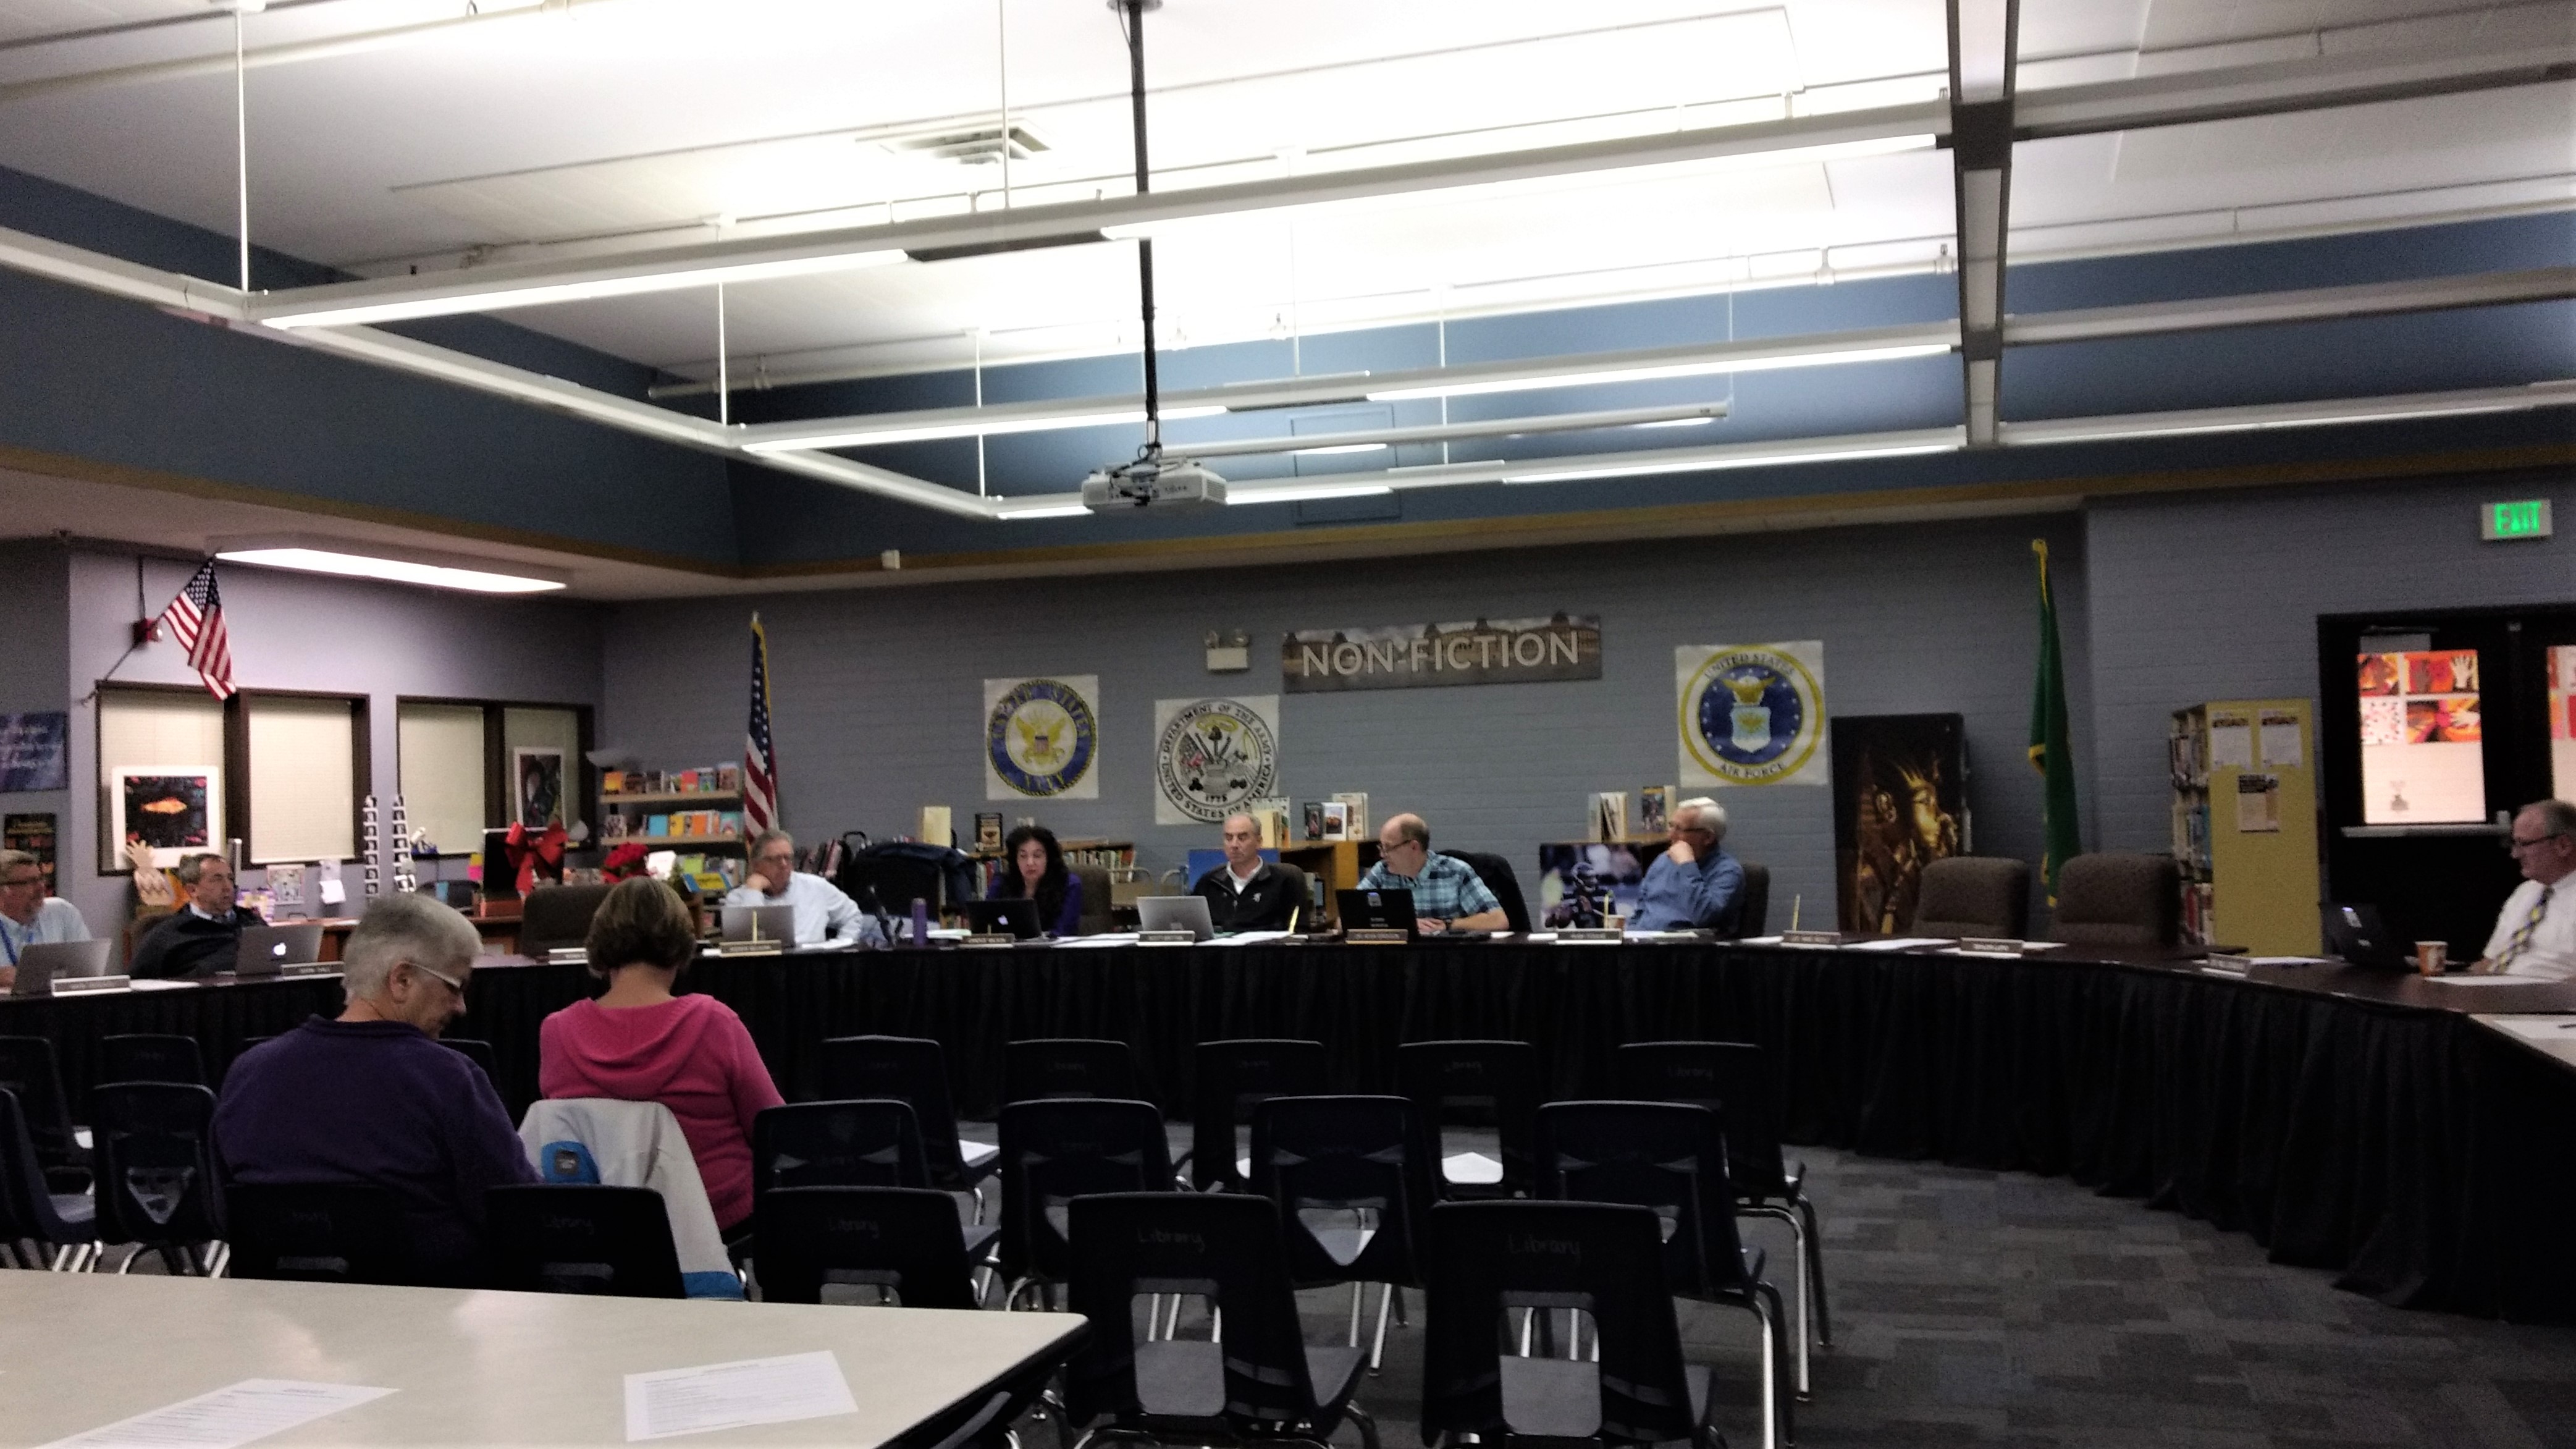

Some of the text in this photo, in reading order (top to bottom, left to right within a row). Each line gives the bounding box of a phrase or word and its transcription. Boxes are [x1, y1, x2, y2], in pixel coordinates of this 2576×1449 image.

[2494, 501, 2543, 536] EXIT
[1302, 630, 1580, 677] NON-FICTION
[1136, 1226, 1206, 1254] Library
[1507, 1232, 1582, 1259] Library
